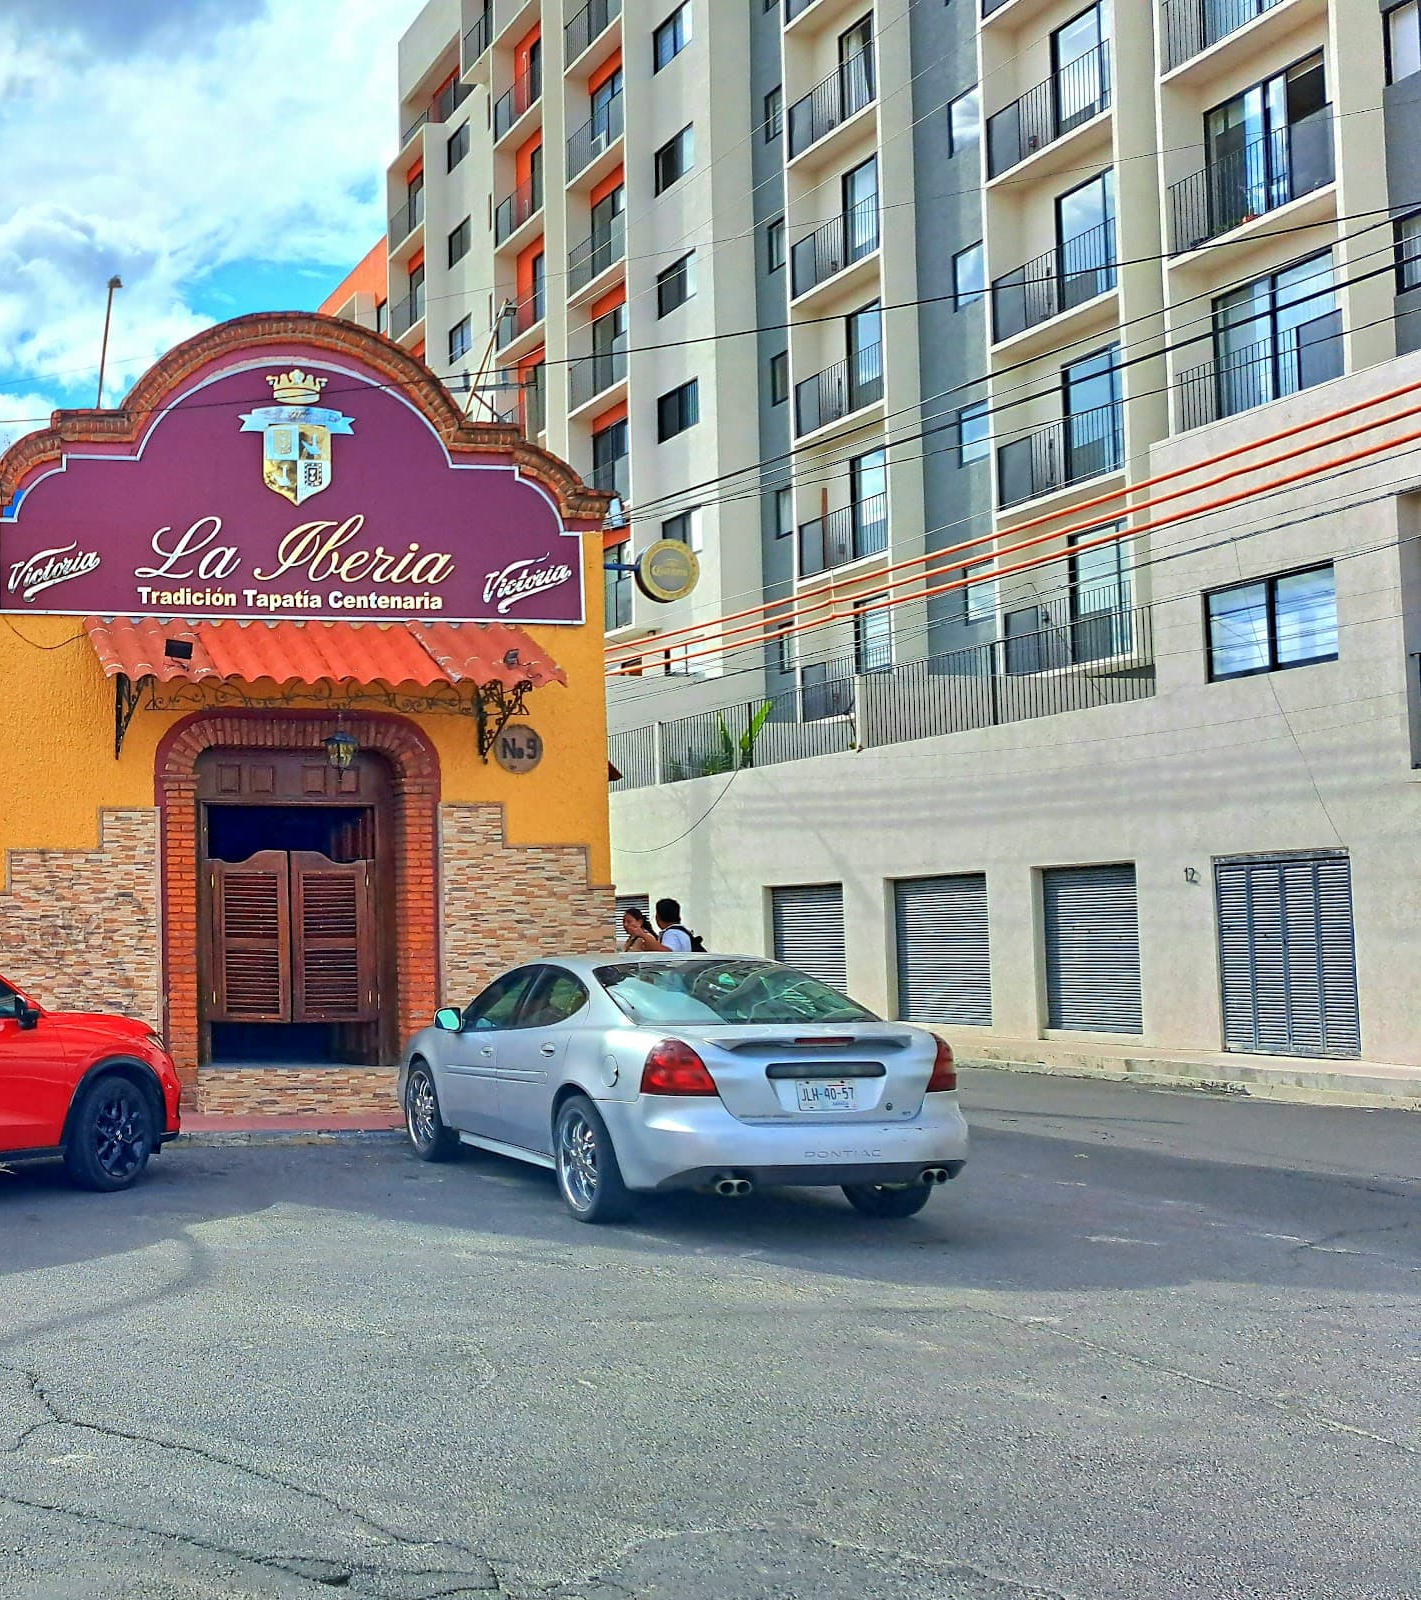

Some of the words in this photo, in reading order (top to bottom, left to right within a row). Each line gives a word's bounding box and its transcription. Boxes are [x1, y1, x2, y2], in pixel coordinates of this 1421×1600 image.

[7, 539, 102, 603] Victoria
[134, 516, 242, 581] La
[253, 514, 456, 585] Iberia
[137, 586, 238, 607] Tradición
[242, 589, 323, 611] Tapatía
[328, 590, 443, 610] Centenaria
[482, 552, 572, 614] Victoria
[801, 1087, 854, 1102] JLH-40-57
[804, 1149, 882, 1159] PONTIAC
